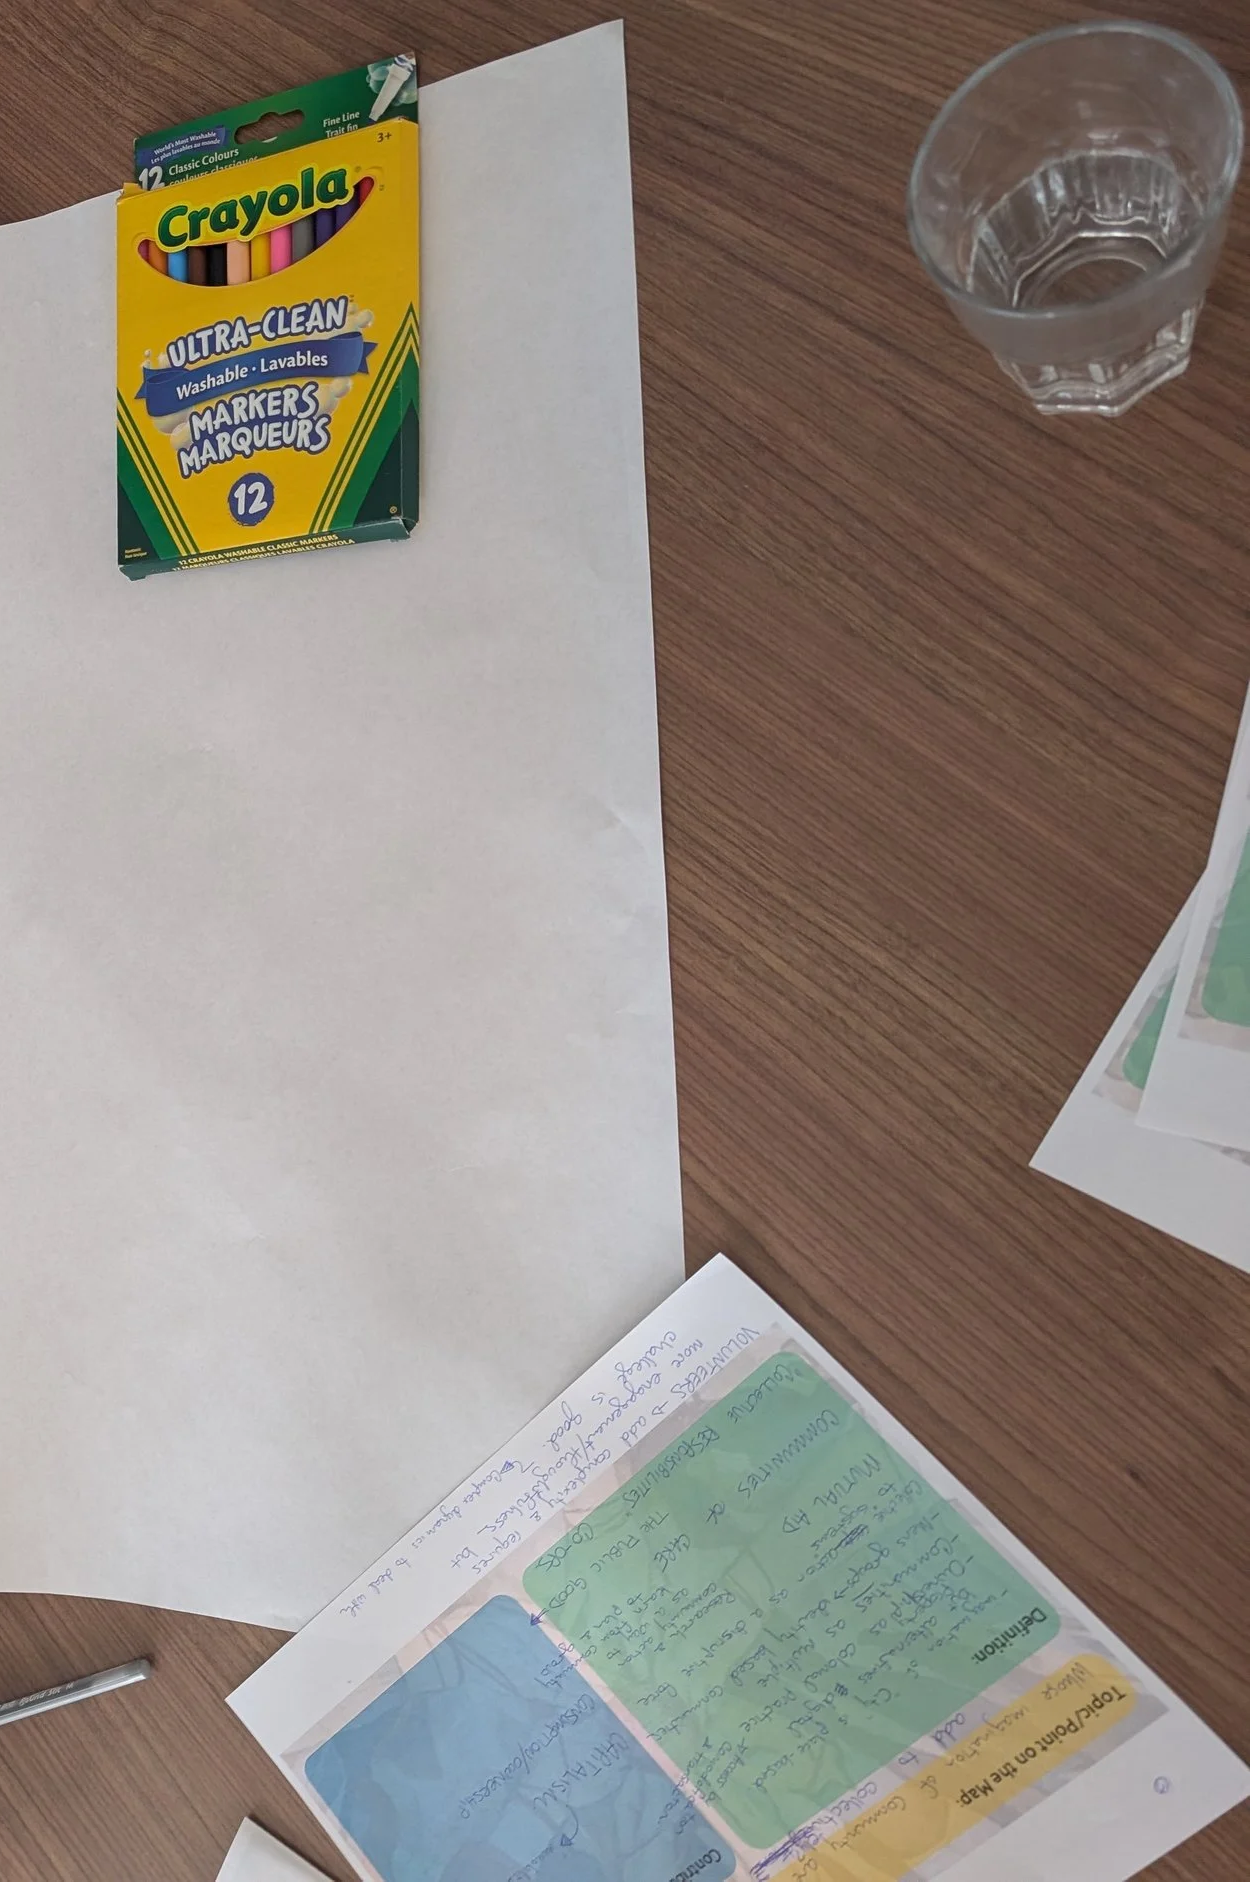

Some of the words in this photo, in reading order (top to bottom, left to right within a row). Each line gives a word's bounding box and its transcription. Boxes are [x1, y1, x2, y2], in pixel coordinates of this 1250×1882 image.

[323, 116, 340, 127] Fine
[342, 111, 360, 122] Line
[326, 126, 345, 138] Trait
[150, 157, 160, 165] Les
[201, 138, 221, 147] monde
[153, 141, 174, 155] World's
[175, 137, 189, 147] Most
[190, 131, 217, 142] Washable
[377, 132, 392, 143] 3+
[169, 159, 201, 176] Classic
[202, 148, 239, 166] Colours
[139, 166, 165, 191] 12
[157, 167, 349, 248] Crayola
[165, 295, 349, 368] ULTRA-CLEAN
[176, 365, 248, 400] Washable
[260, 351, 328, 374] Lavables
[189, 382, 319, 442] MARKERS
[178, 415, 331, 479] MARQUEURS
[233, 481, 269, 516] 12
[188, 553, 224, 565] CRAYOLA
[224, 546, 266, 559] WASHABLE
[267, 540, 299, 552] CLASSIC
[300, 534, 338, 546] MARKERS
[316, 538, 356, 551] CRAYOLA
[670, 1327, 759, 1398] VOLUNTEERS
[671, 1339, 703, 1365] more
[591, 1392, 604, 1405] is
[542, 1401, 581, 1450] good.
[620, 1415, 646, 1446] add
[737, 1411, 838, 1498] COMMUNITIES
[540, 1449, 610, 1508] complexity
[813, 1453, 880, 1503] MUTUAL
[783, 1509, 810, 1532] AID
[396, 1557, 409, 1567] to
[452, 1545, 475, 1567] but
[471, 1530, 520, 1573] requires
[590, 1533, 638, 1572] PUBLIC
[652, 1533, 690, 1571] CARE
[550, 1576, 585, 1608] GOOD
[970, 1607, 1046, 1664] Definition:
[931, 1713, 965, 1749] add
[1034, 1684, 1125, 1751] Topic/Point
[531, 1733, 628, 1808] CAPITALISM
[897, 1752, 915, 1767] to
[990, 1761, 1017, 1782] the
[1014, 1746, 1037, 1766] on
[955, 1778, 993, 1808] Map:
